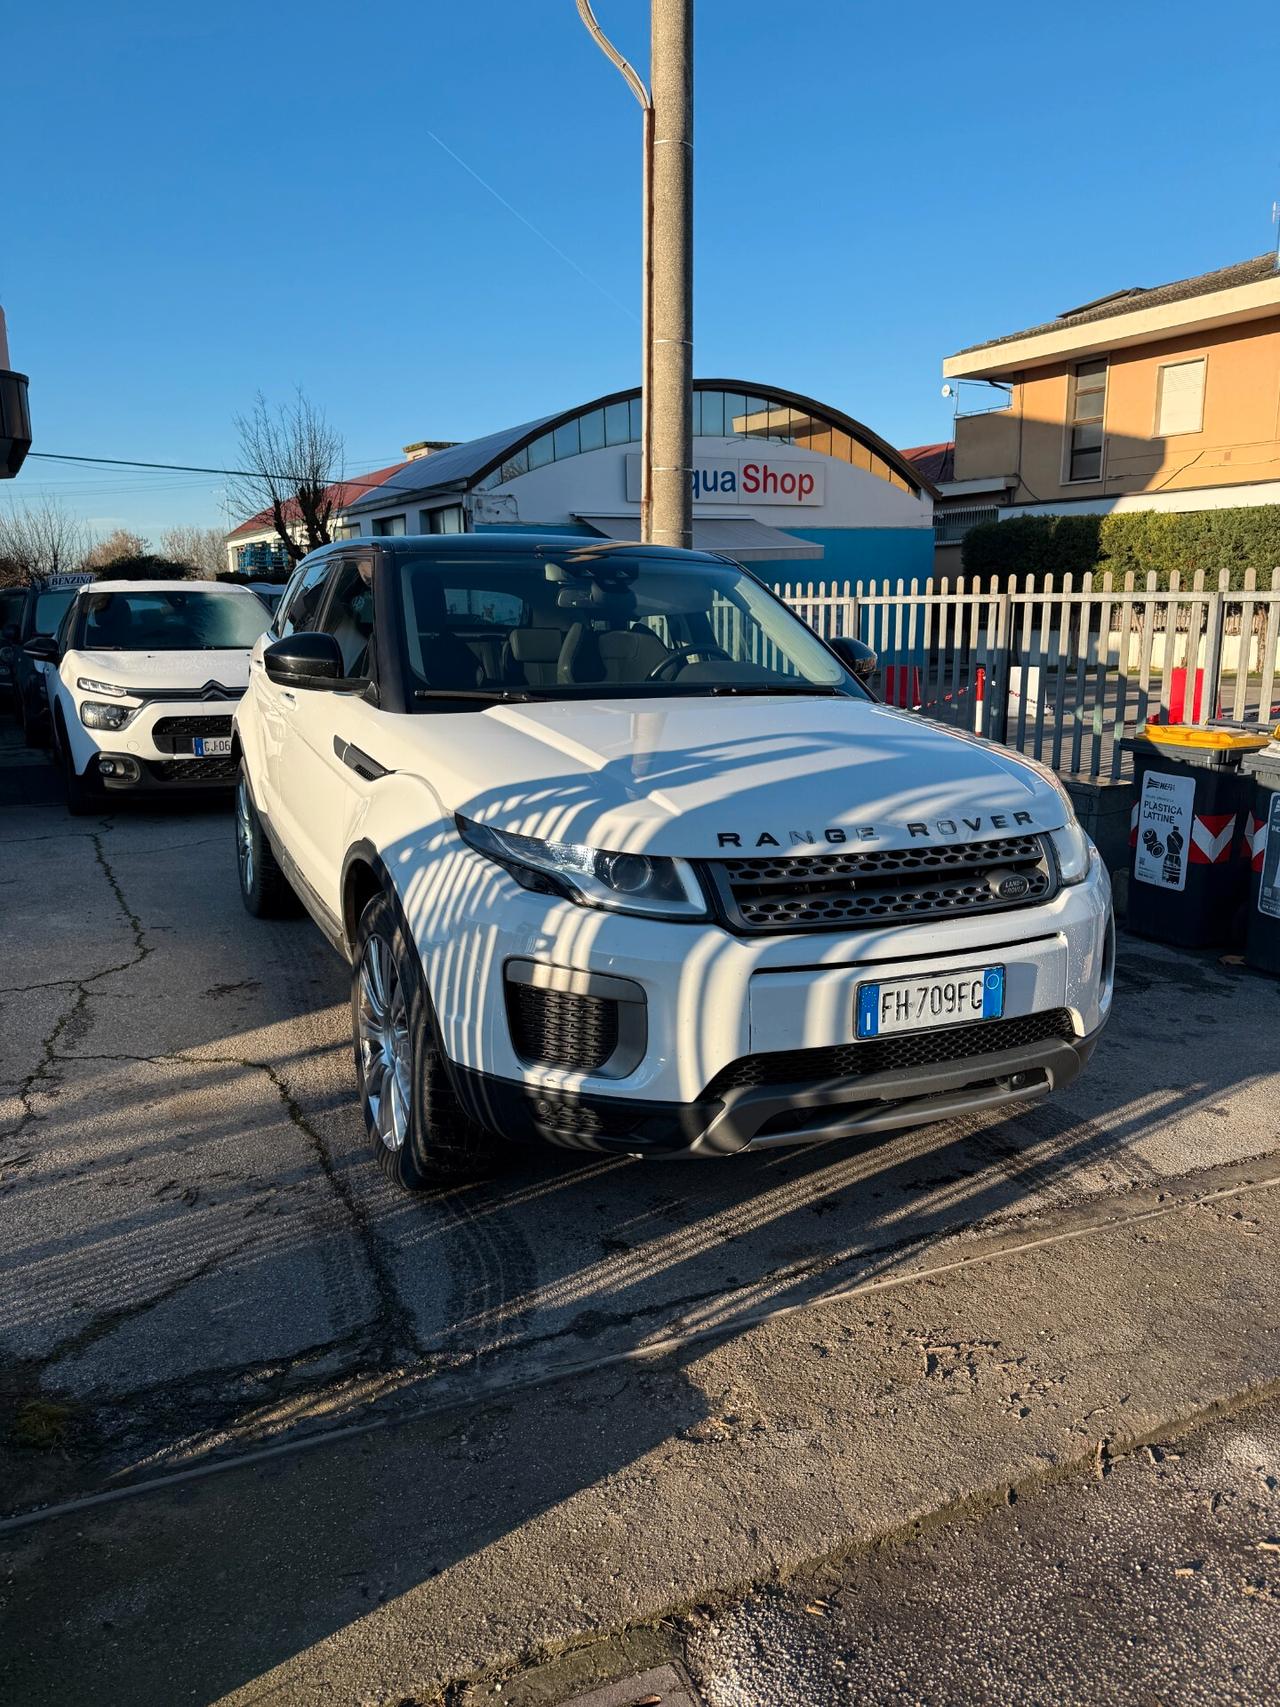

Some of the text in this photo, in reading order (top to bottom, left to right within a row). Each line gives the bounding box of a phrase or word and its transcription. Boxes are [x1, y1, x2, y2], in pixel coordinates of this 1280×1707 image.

[742, 464, 815, 502] Shop
[51, 576, 93, 585] BENZINA
[1144, 800, 1183, 816] PLASTICA
[1143, 810, 1175, 825] LATTINE
[717, 811, 1034, 848] RANGE ROVER
